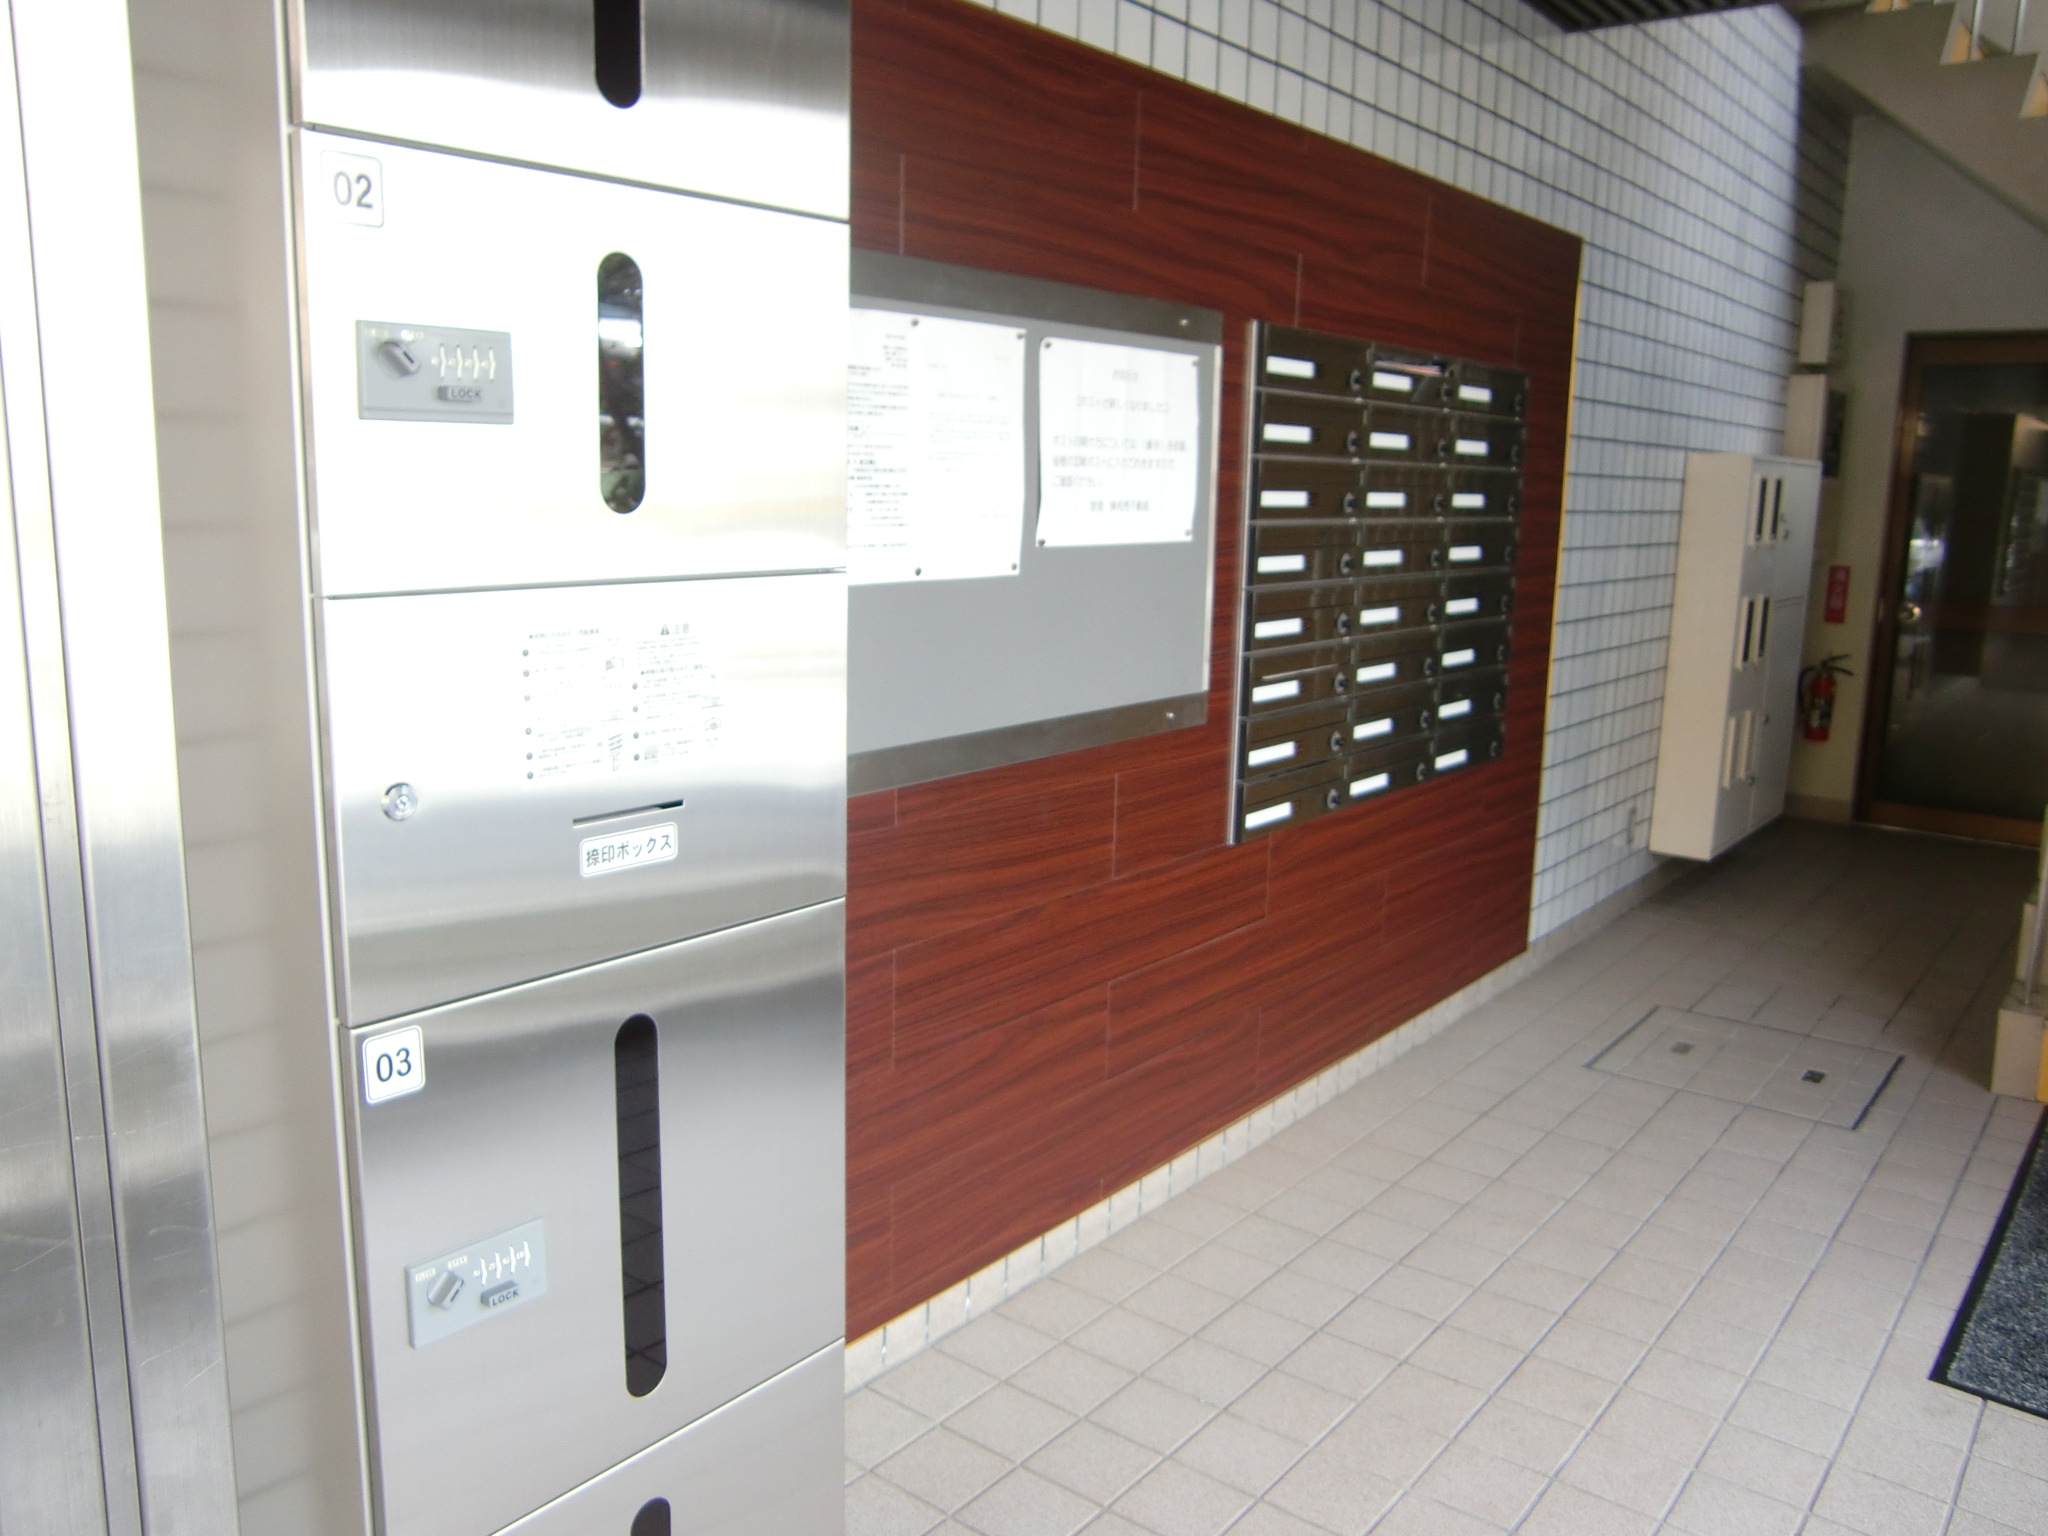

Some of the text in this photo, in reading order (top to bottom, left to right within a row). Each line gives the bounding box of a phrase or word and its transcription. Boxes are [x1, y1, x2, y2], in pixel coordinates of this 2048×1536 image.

[333, 170, 374, 209] 02
[451, 387, 483, 399] LOCK
[586, 834, 672, 868] 捺印ボックス
[375, 1047, 413, 1084] 03
[491, 1288, 520, 1307] LOCK
